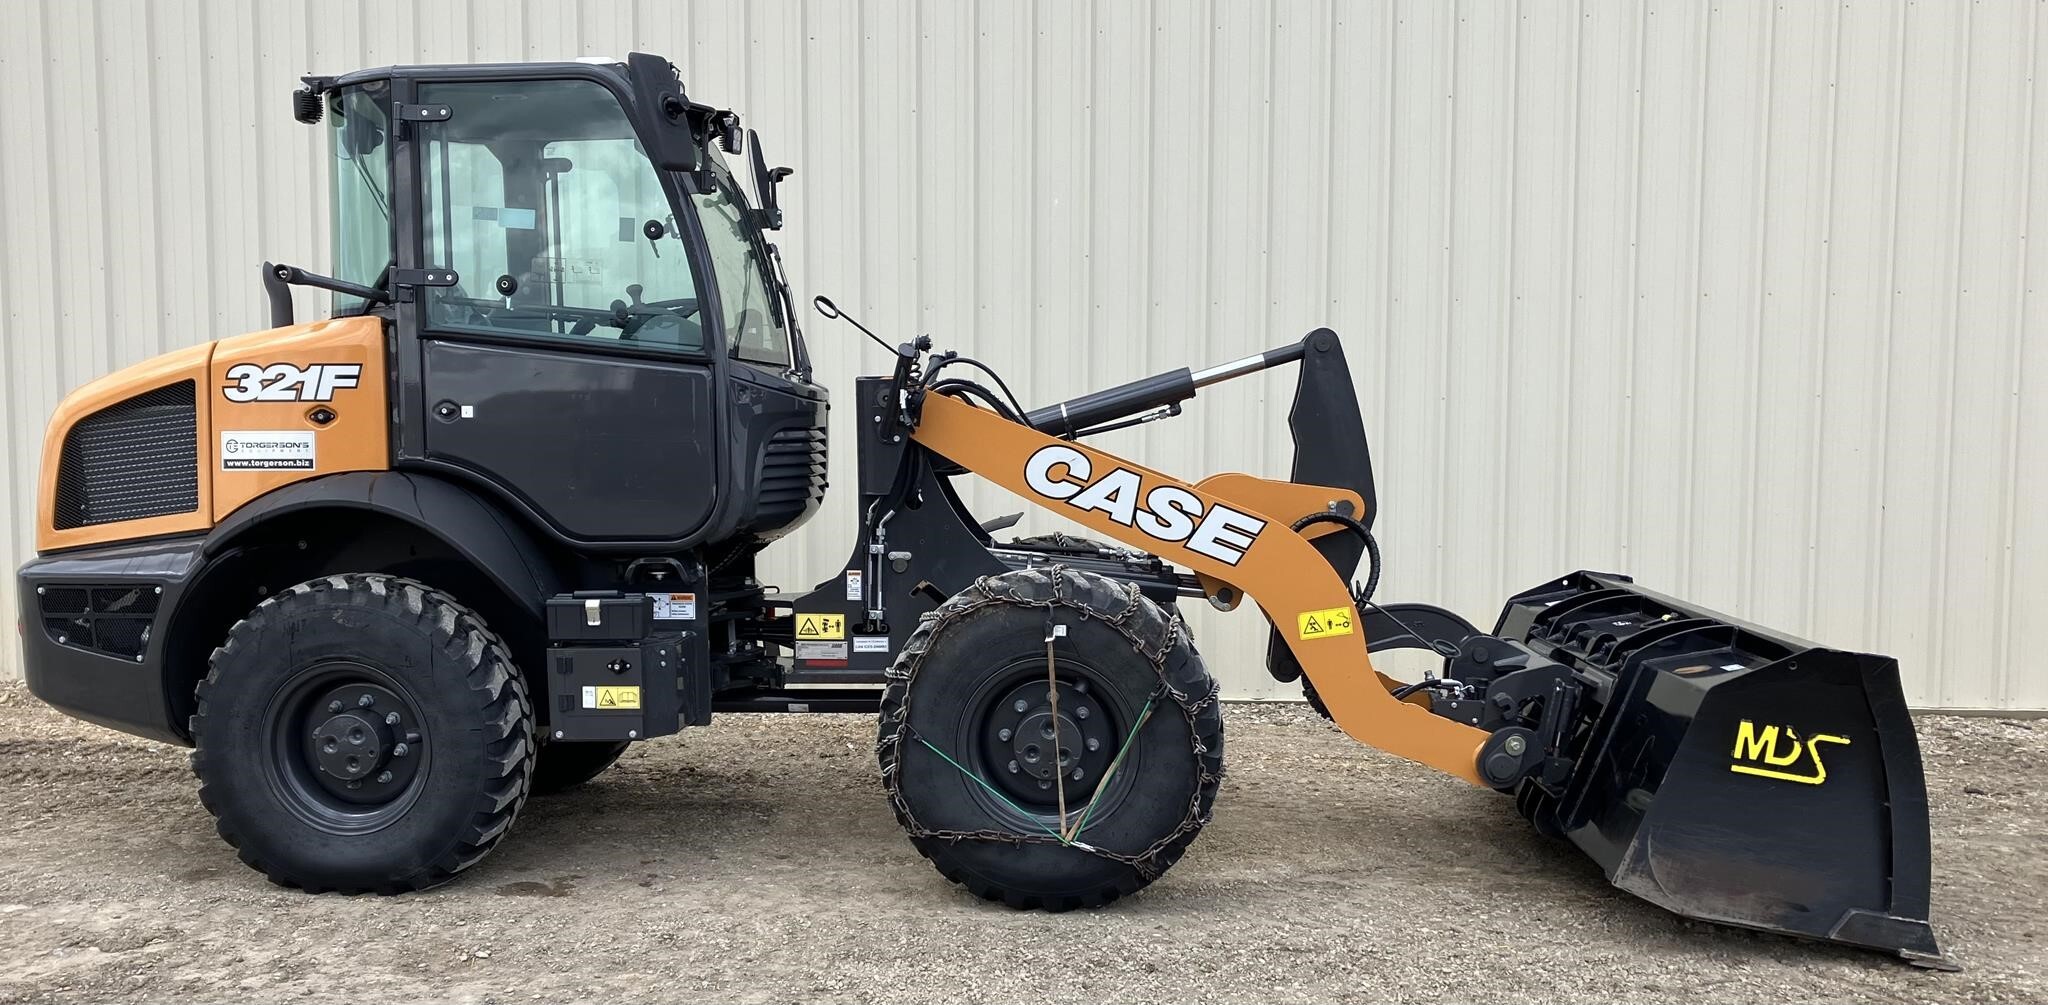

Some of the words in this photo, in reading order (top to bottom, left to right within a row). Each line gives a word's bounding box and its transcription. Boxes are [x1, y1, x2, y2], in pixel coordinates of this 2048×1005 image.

[222, 363, 363, 403] 321F
[226, 460, 310, 468] www.torgerson.biz
[1024, 444, 1268, 567] CASE
[1731, 720, 1851, 785] MDS
